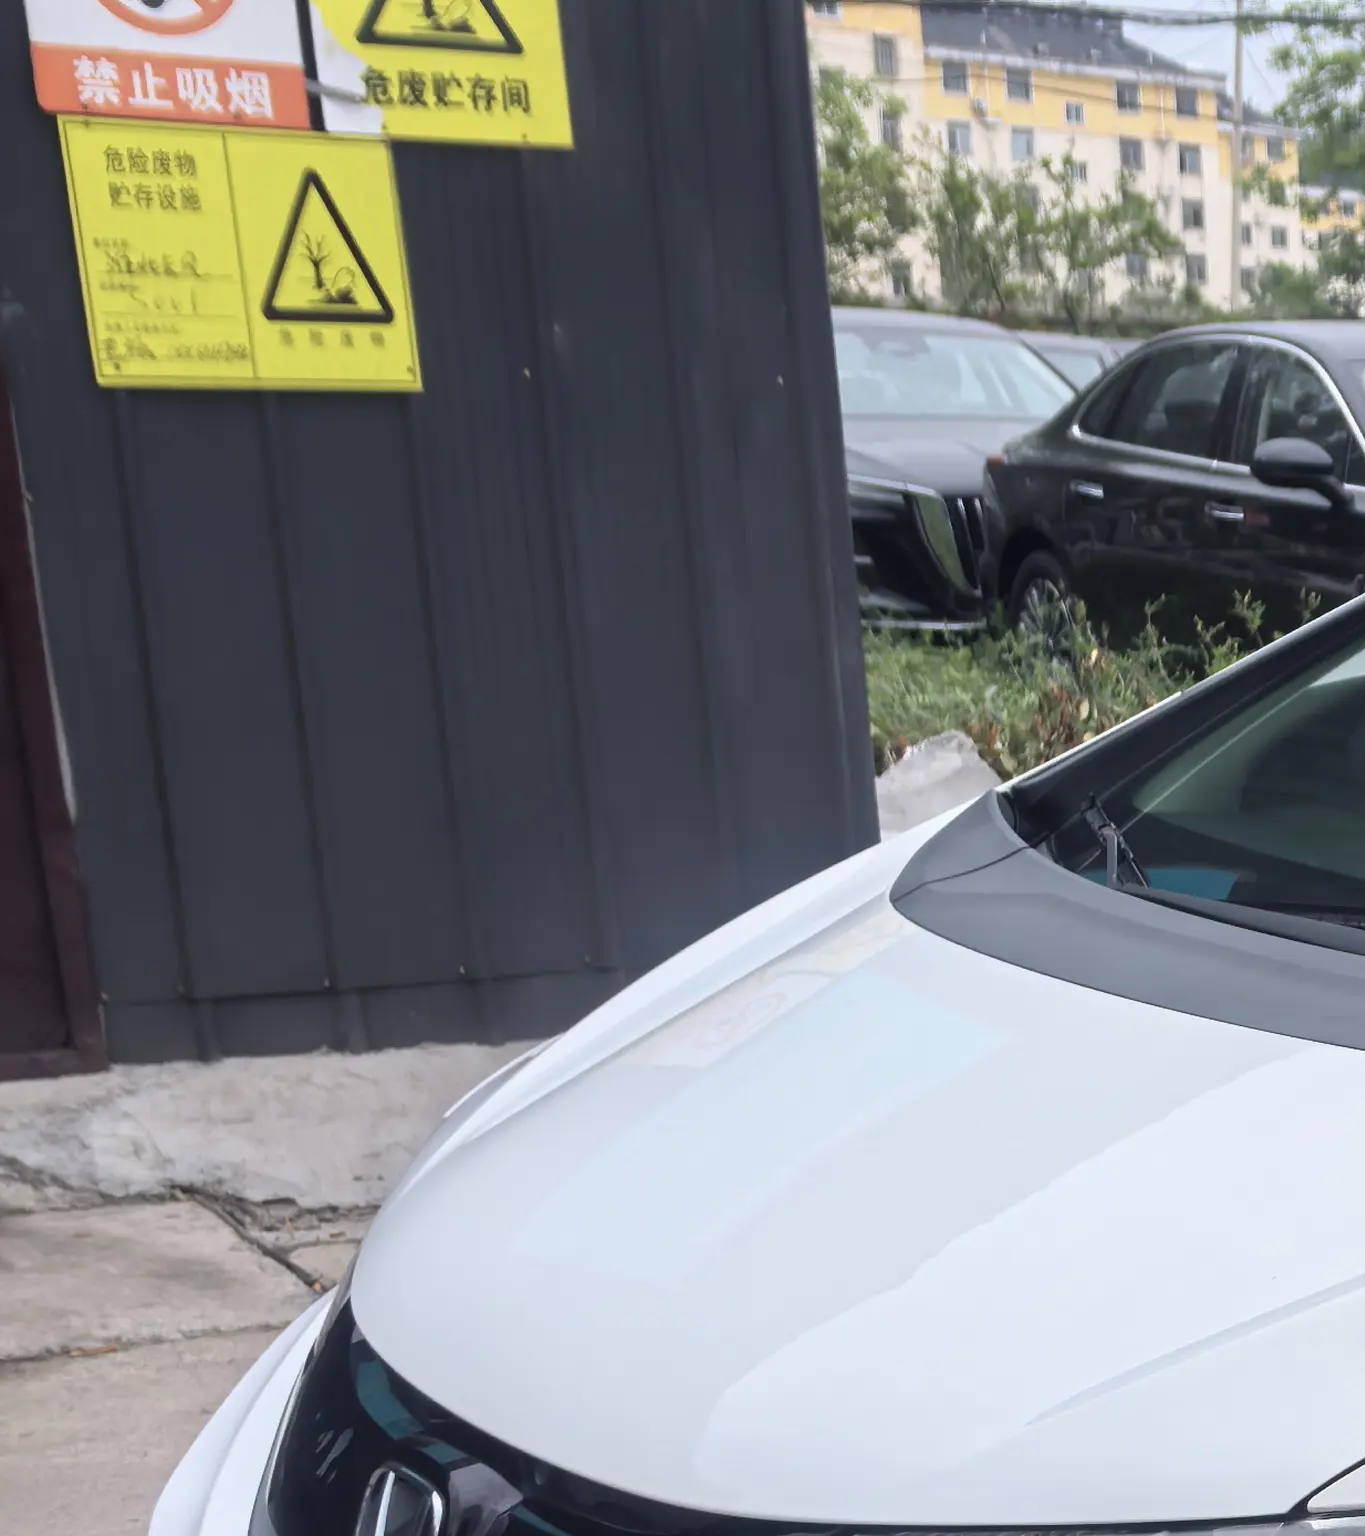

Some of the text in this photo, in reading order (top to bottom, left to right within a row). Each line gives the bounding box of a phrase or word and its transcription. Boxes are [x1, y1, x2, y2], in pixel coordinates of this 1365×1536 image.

[73, 55, 274, 119] 禁止吸烟
[361, 65, 532, 114] 危废贮存间
[103, 144, 198, 176] 危险废物
[108, 180, 202, 212] 贮存设施
